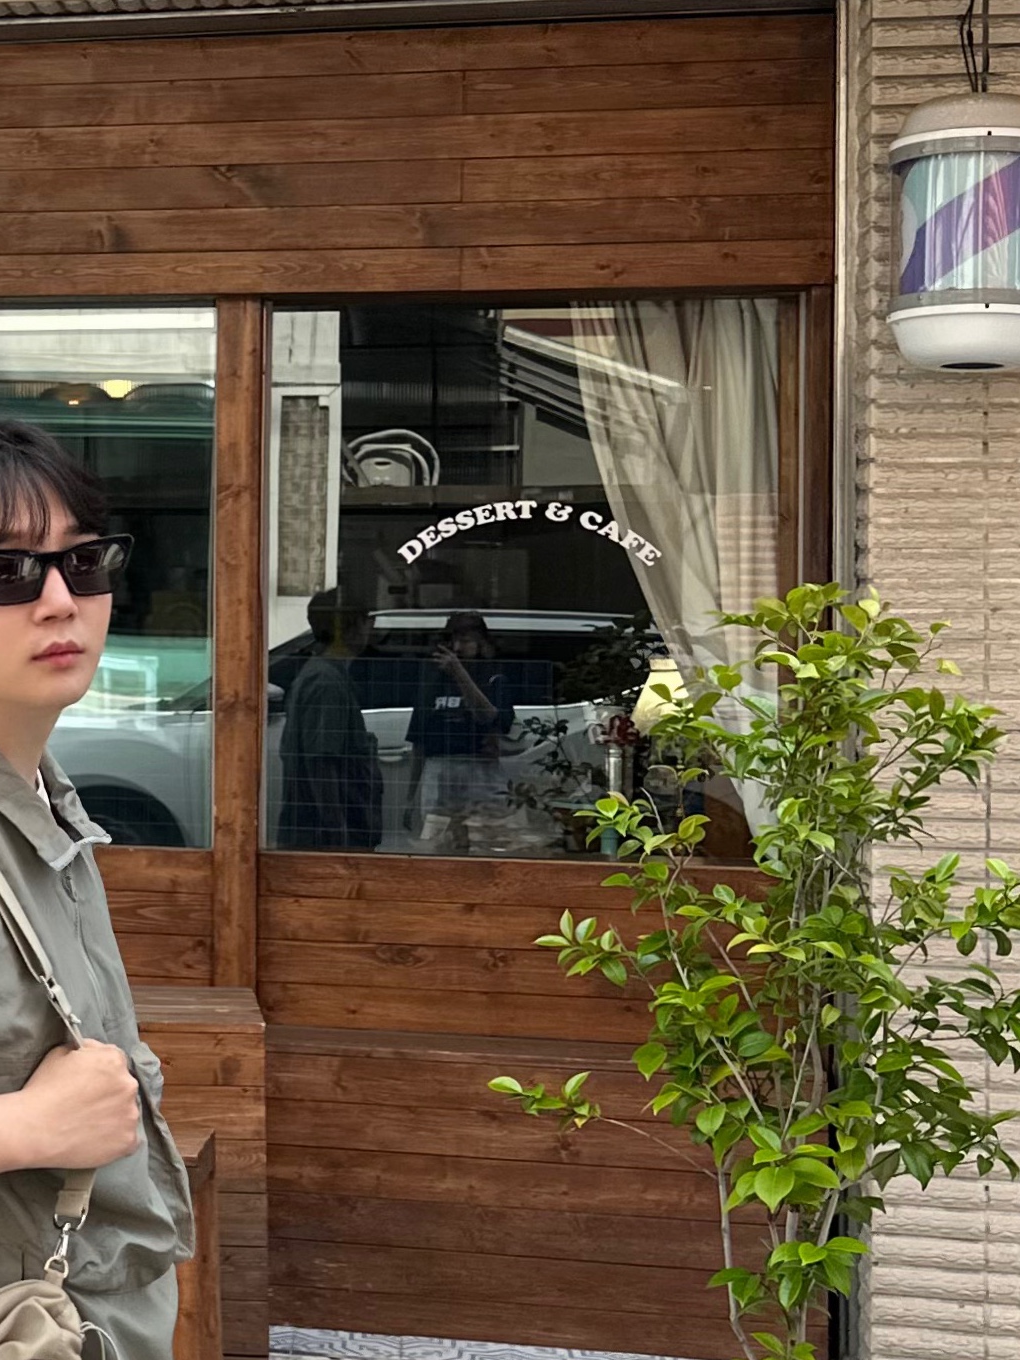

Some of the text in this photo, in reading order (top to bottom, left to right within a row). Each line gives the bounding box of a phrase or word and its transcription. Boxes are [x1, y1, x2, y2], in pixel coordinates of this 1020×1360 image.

[397, 500, 662, 567] DESSERT & CAFE
